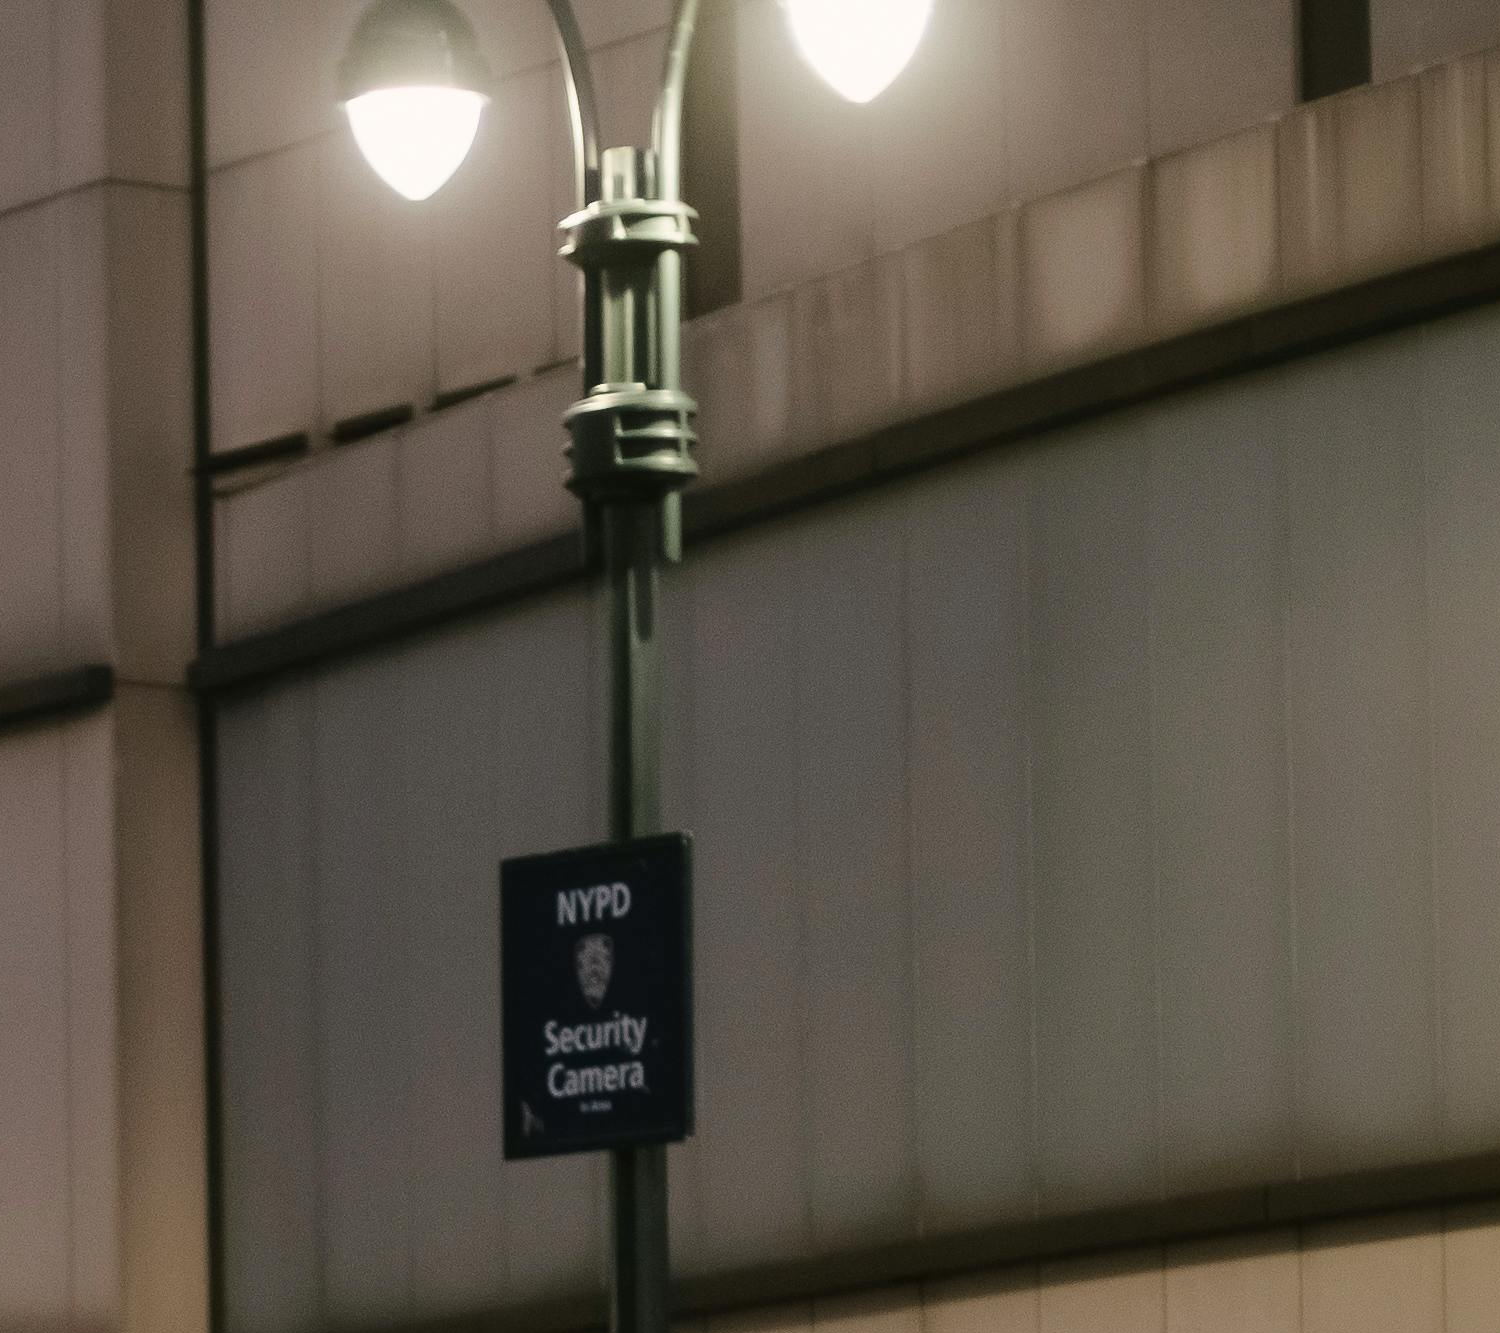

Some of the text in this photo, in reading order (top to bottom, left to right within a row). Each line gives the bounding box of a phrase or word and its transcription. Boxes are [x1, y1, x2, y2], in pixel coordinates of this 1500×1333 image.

[556, 882, 632, 925] NYPD
[544, 1011, 648, 1056] Security
[547, 1061, 646, 1098] Camera
